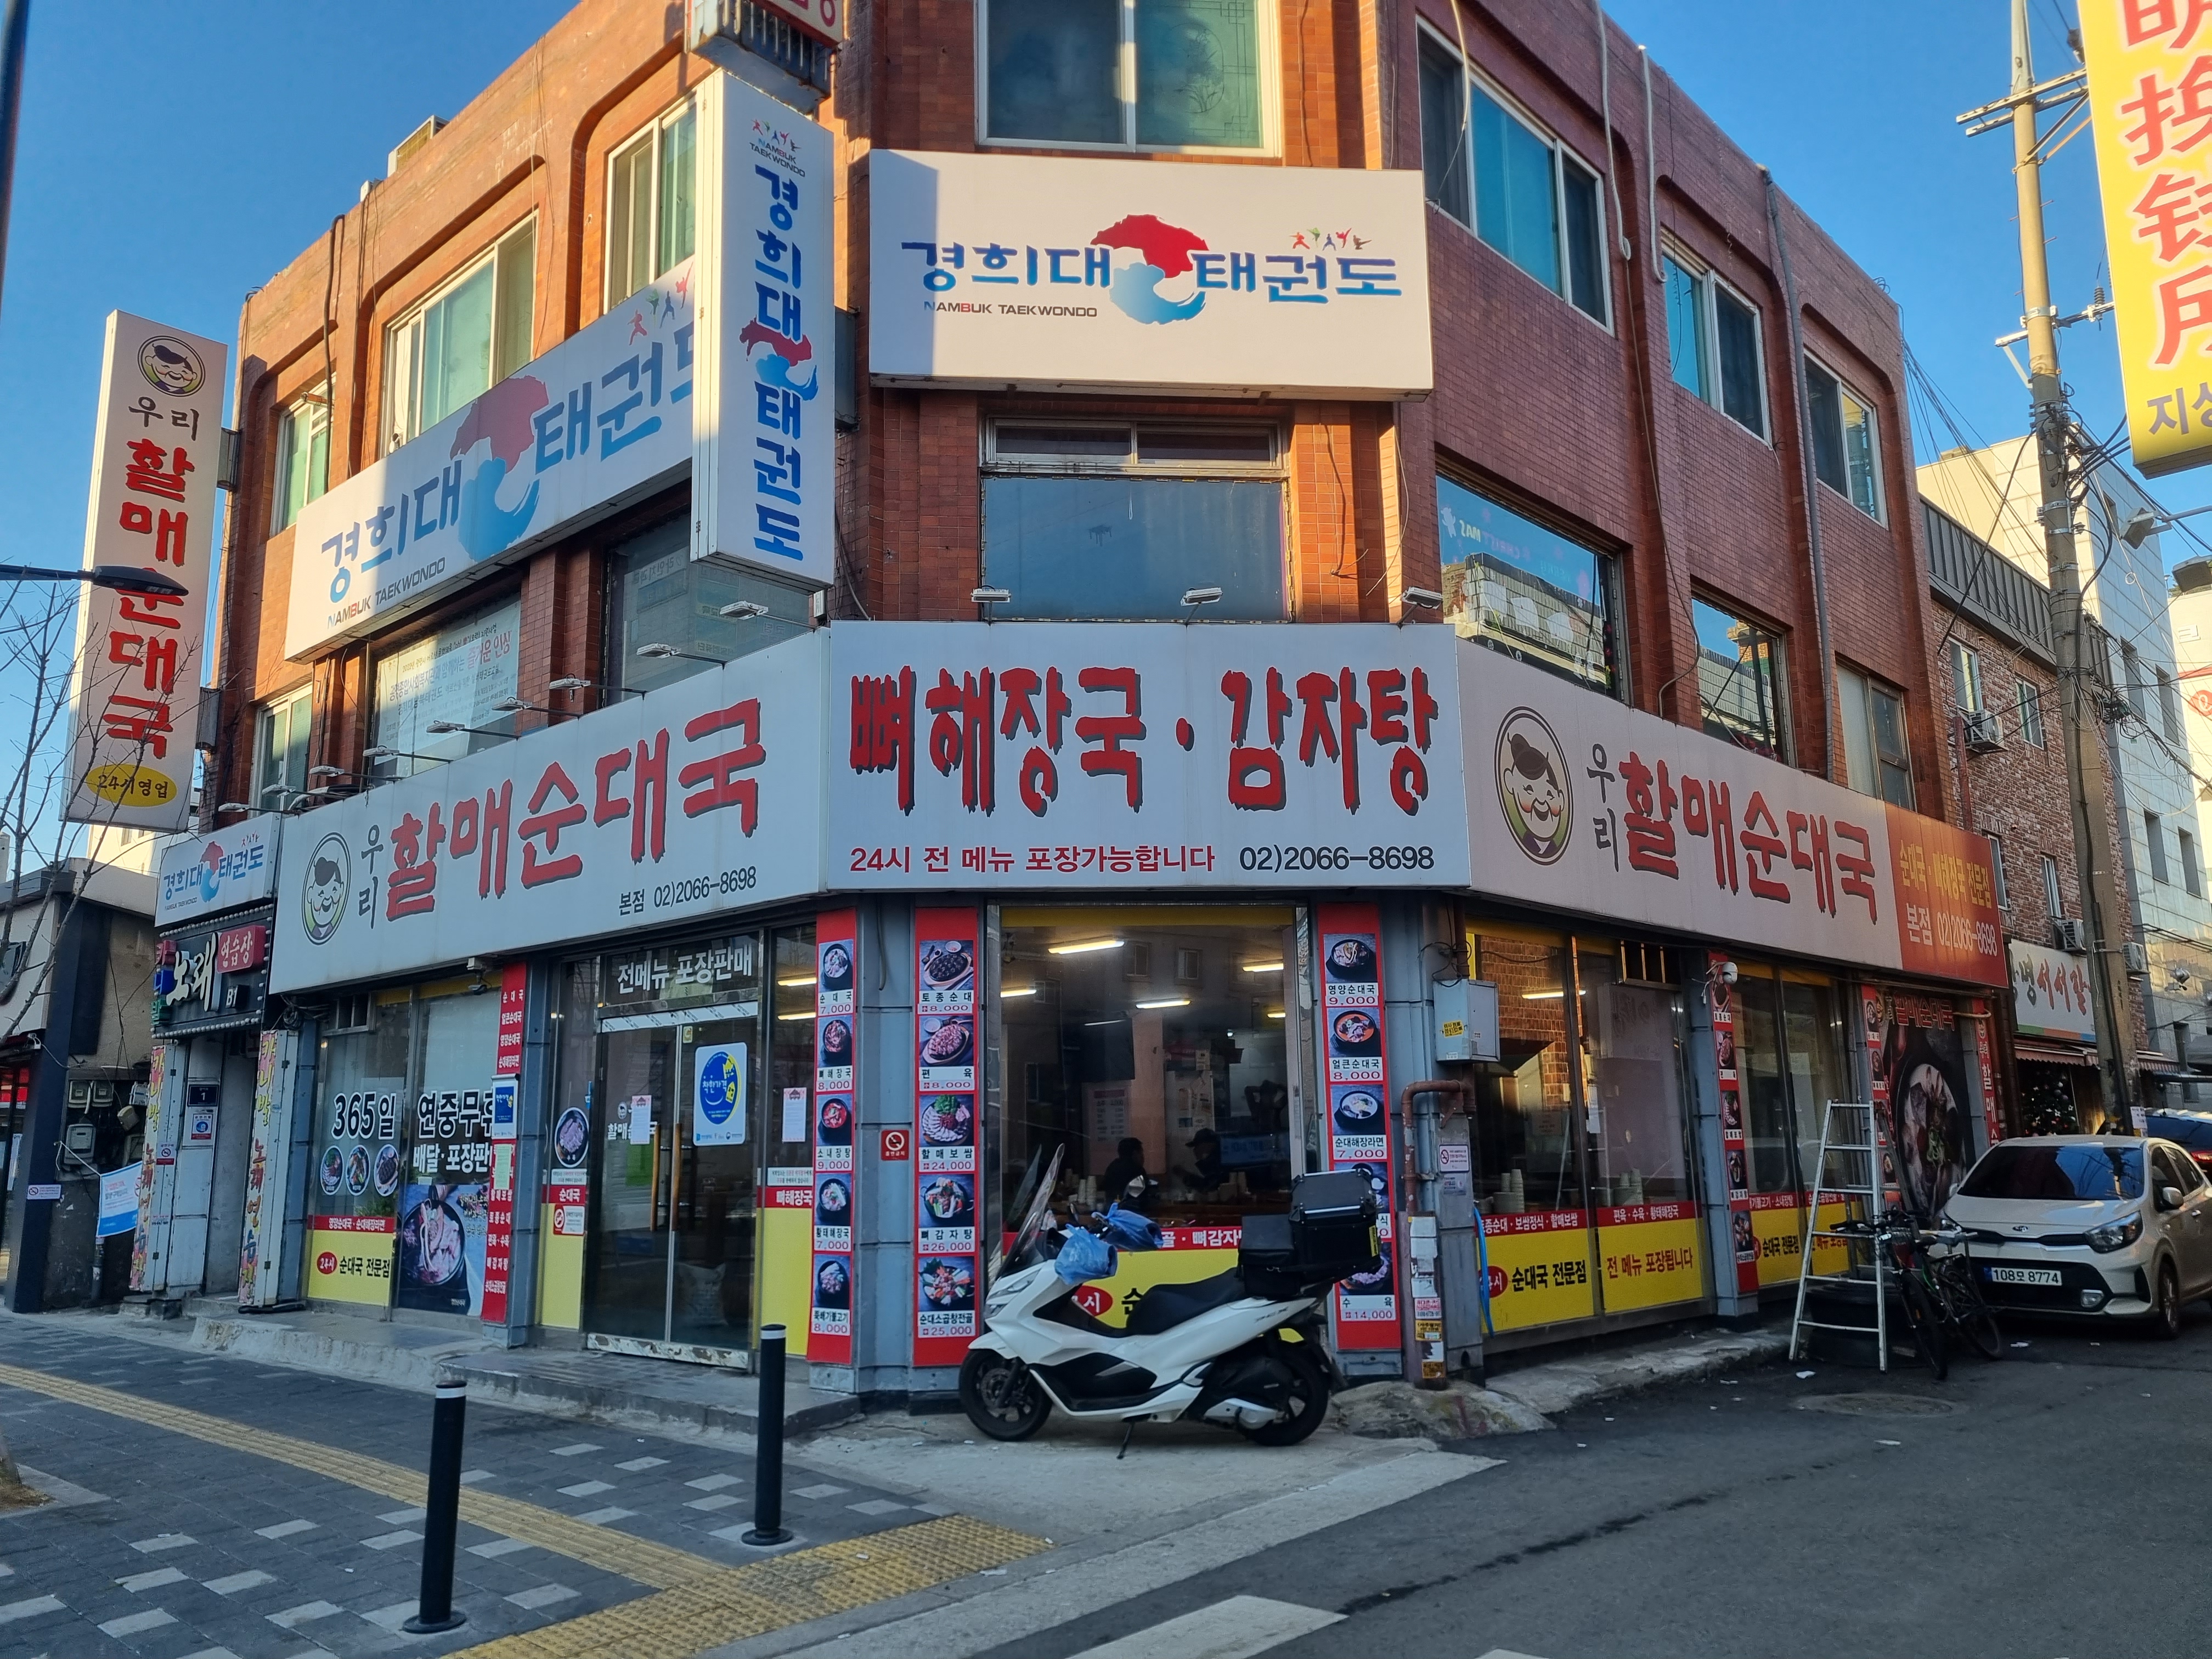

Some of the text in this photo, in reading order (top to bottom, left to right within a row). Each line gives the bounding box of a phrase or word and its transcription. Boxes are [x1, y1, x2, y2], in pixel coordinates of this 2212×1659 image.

[749, 142, 805, 178] TAEKWONDO
[758, 138, 797, 164] NAMBUK
[755, 165, 801, 342] 경희대
[901, 242, 1402, 304] 경희대 태권도
[924, 300, 1097, 319] NAMBUK TAEKWONDO
[128, 396, 201, 441] 우리
[753, 381, 804, 561] 태권도
[321, 459, 463, 603] 경희대
[328, 557, 445, 630] NAMBUK TAEKWONDO
[850, 665, 1439, 817] 뼈해장국 감자탕
[386, 698, 767, 922] 할매순대국
[1587, 743, 1620, 872] 우리
[1618, 751, 1878, 926] 할매순대국
[164, 844, 264, 901] 경희대 태권도
[850, 845, 1435, 874] 24시 전 메뉴 포장가능합니다 02)2066-8698
[1900, 840, 1992, 909] 순대국 뼈해장국 전문점
[358, 823, 384, 929] 우리
[619, 866, 757, 917] 본점 02)2066-8698
[1906, 902, 1997, 956] 본점 02)2066-8698
[221, 930, 253, 968] 연습장
[166, 932, 218, 1013] 노래
[617, 943, 753, 996] 전메뉴 포장판매
[226, 987, 238, 1008] B1
[503, 989, 524, 1003] 순대국
[820, 991, 852, 1004] 순대국
[922, 992, 972, 1002] 토종순대
[1328, 984, 1375, 995] 영양순대국
[2036, 958, 2091, 1016] 서서갈
[1332, 1059, 1380, 1070] 얼큰순대국
[201, 1092, 206, 1101] 1
[703, 1079, 727, 1094] 착한가격
[331, 1091, 396, 1141] 365일
[413, 1143, 440, 1173] 배달
[445, 1142, 492, 1173] 포장판
[921, 1148, 973, 1159] 할매보쌈
[1335, 1136, 1384, 1148] 순대해장라면
[558, 1188, 580, 1203] 순대국
[776, 1189, 812, 1206] 뼈해장국
[1515, 1214, 1544, 1231] 보쌈정식
[1550, 1212, 1578, 1228] 할매보쌈
[1613, 1210, 1626, 1223] 편육
[1632, 1208, 1645, 1221] 수육
[921, 1229, 973, 1240] 뼈감자탕
[1192, 1229, 1242, 1247] 뼈감자
[1762, 1237, 1781, 1258] 순대국
[1781, 1234, 1800, 1255] 전문점
[340, 1256, 390, 1278] 순대국 전문점
[1511, 1264, 1548, 1292] 순대국
[1552, 1260, 1587, 1286] 전문점
[1606, 1246, 1694, 1279] 전 메뉴 포장됩니다
[2028, 1271, 2059, 1284] 8774
